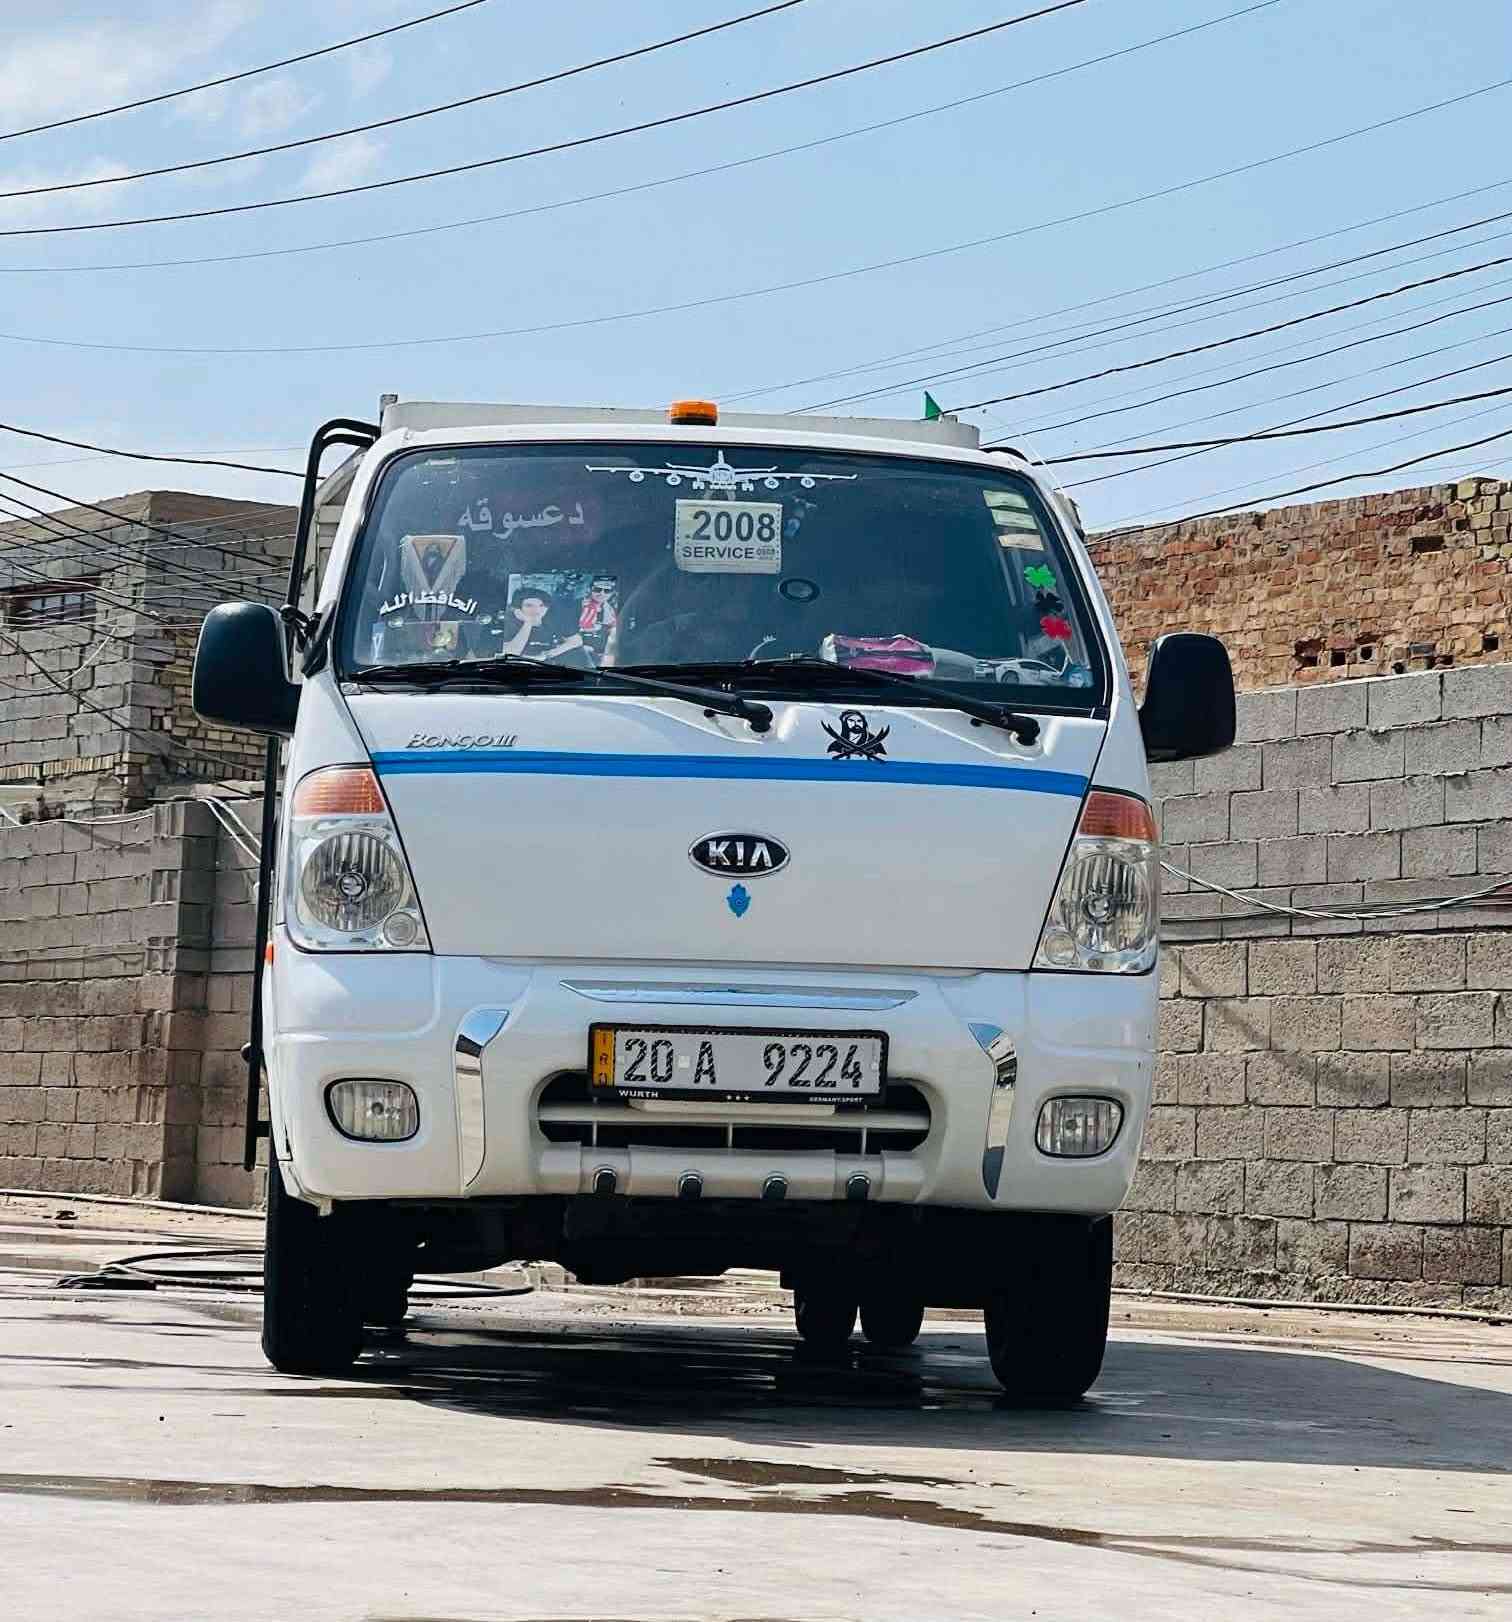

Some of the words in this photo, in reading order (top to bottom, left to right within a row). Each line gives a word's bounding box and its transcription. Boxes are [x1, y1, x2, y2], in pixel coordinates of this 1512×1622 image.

[692, 510, 775, 542] 2008
[682, 545, 755, 559] SERVICE
[379, 591, 414, 615] الله
[708, 840, 775, 867] KIA
[624, 1038, 673, 1082] 20
[693, 1040, 717, 1085] A
[762, 1042, 864, 1089] 9224
